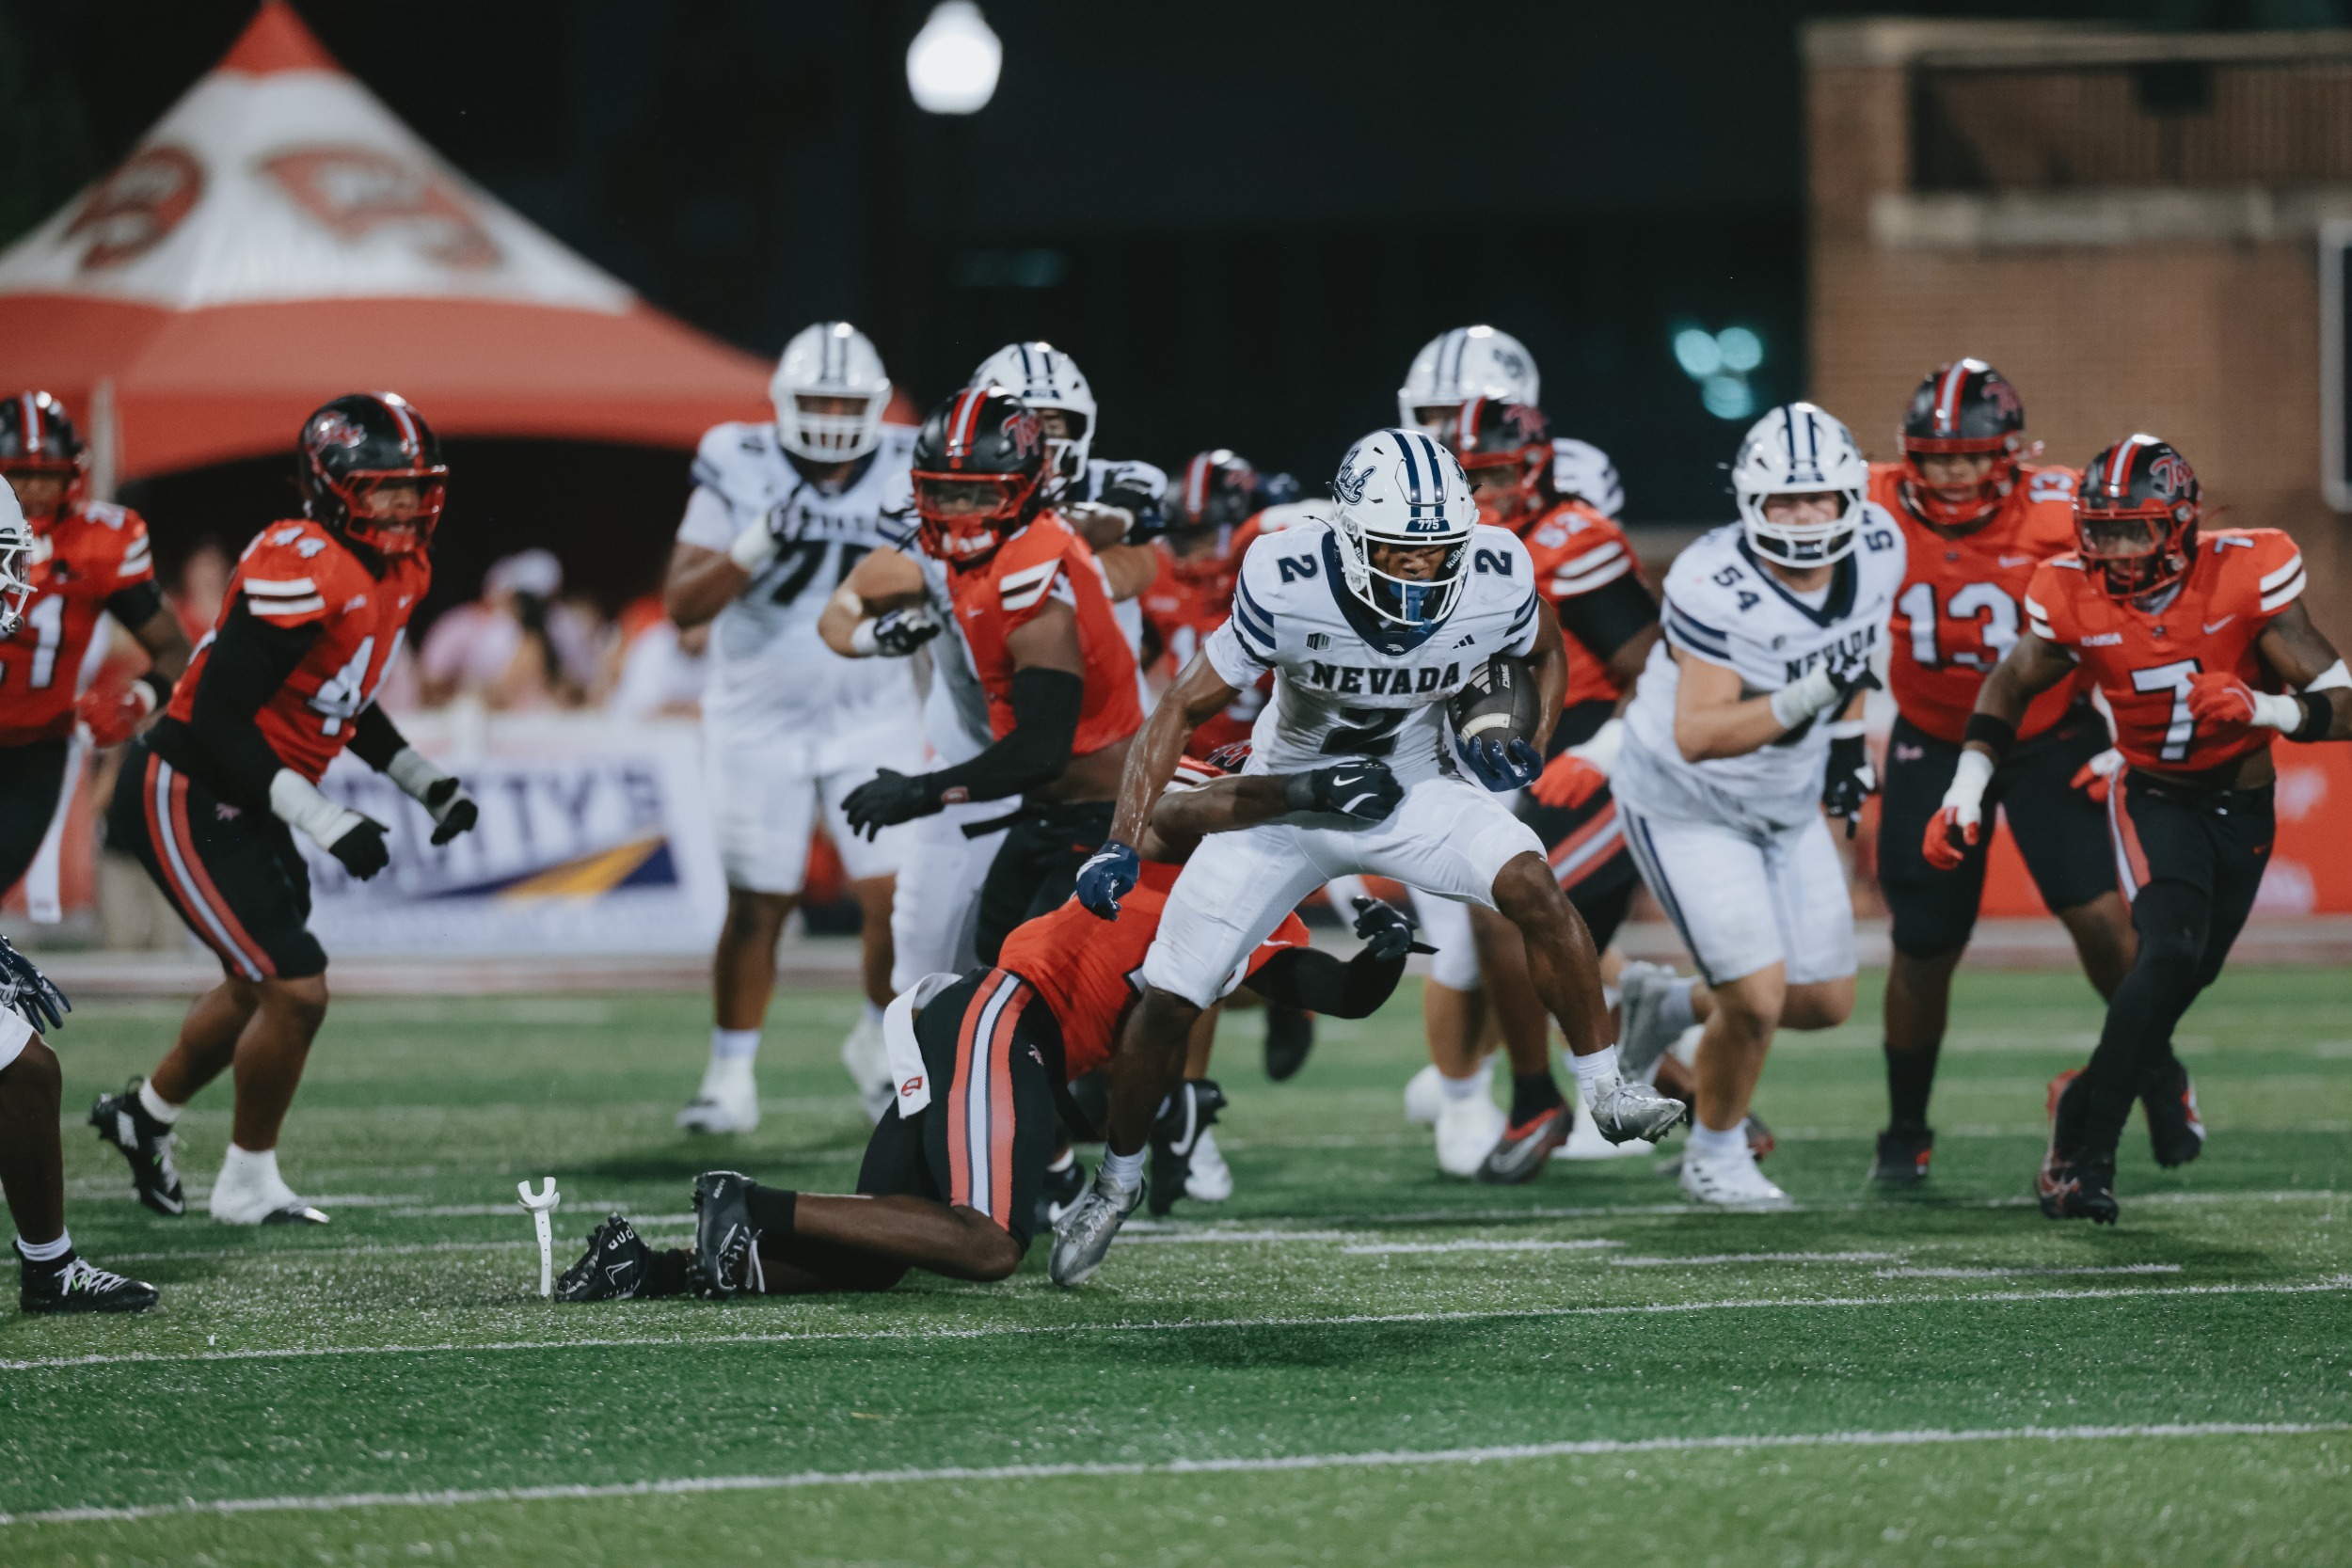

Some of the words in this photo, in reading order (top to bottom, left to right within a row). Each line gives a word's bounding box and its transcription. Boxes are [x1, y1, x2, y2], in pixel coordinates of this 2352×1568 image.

[2029, 472, 2074, 503] 13
[1418, 519, 1440, 531] 775
[1276, 552, 1319, 585] 2
[1474, 547, 1514, 578] 2
[1712, 565, 1761, 613] 54
[1899, 581, 2022, 673] 13
[1311, 660, 1460, 695] NEVADA
[2129, 657, 2204, 763] 7
